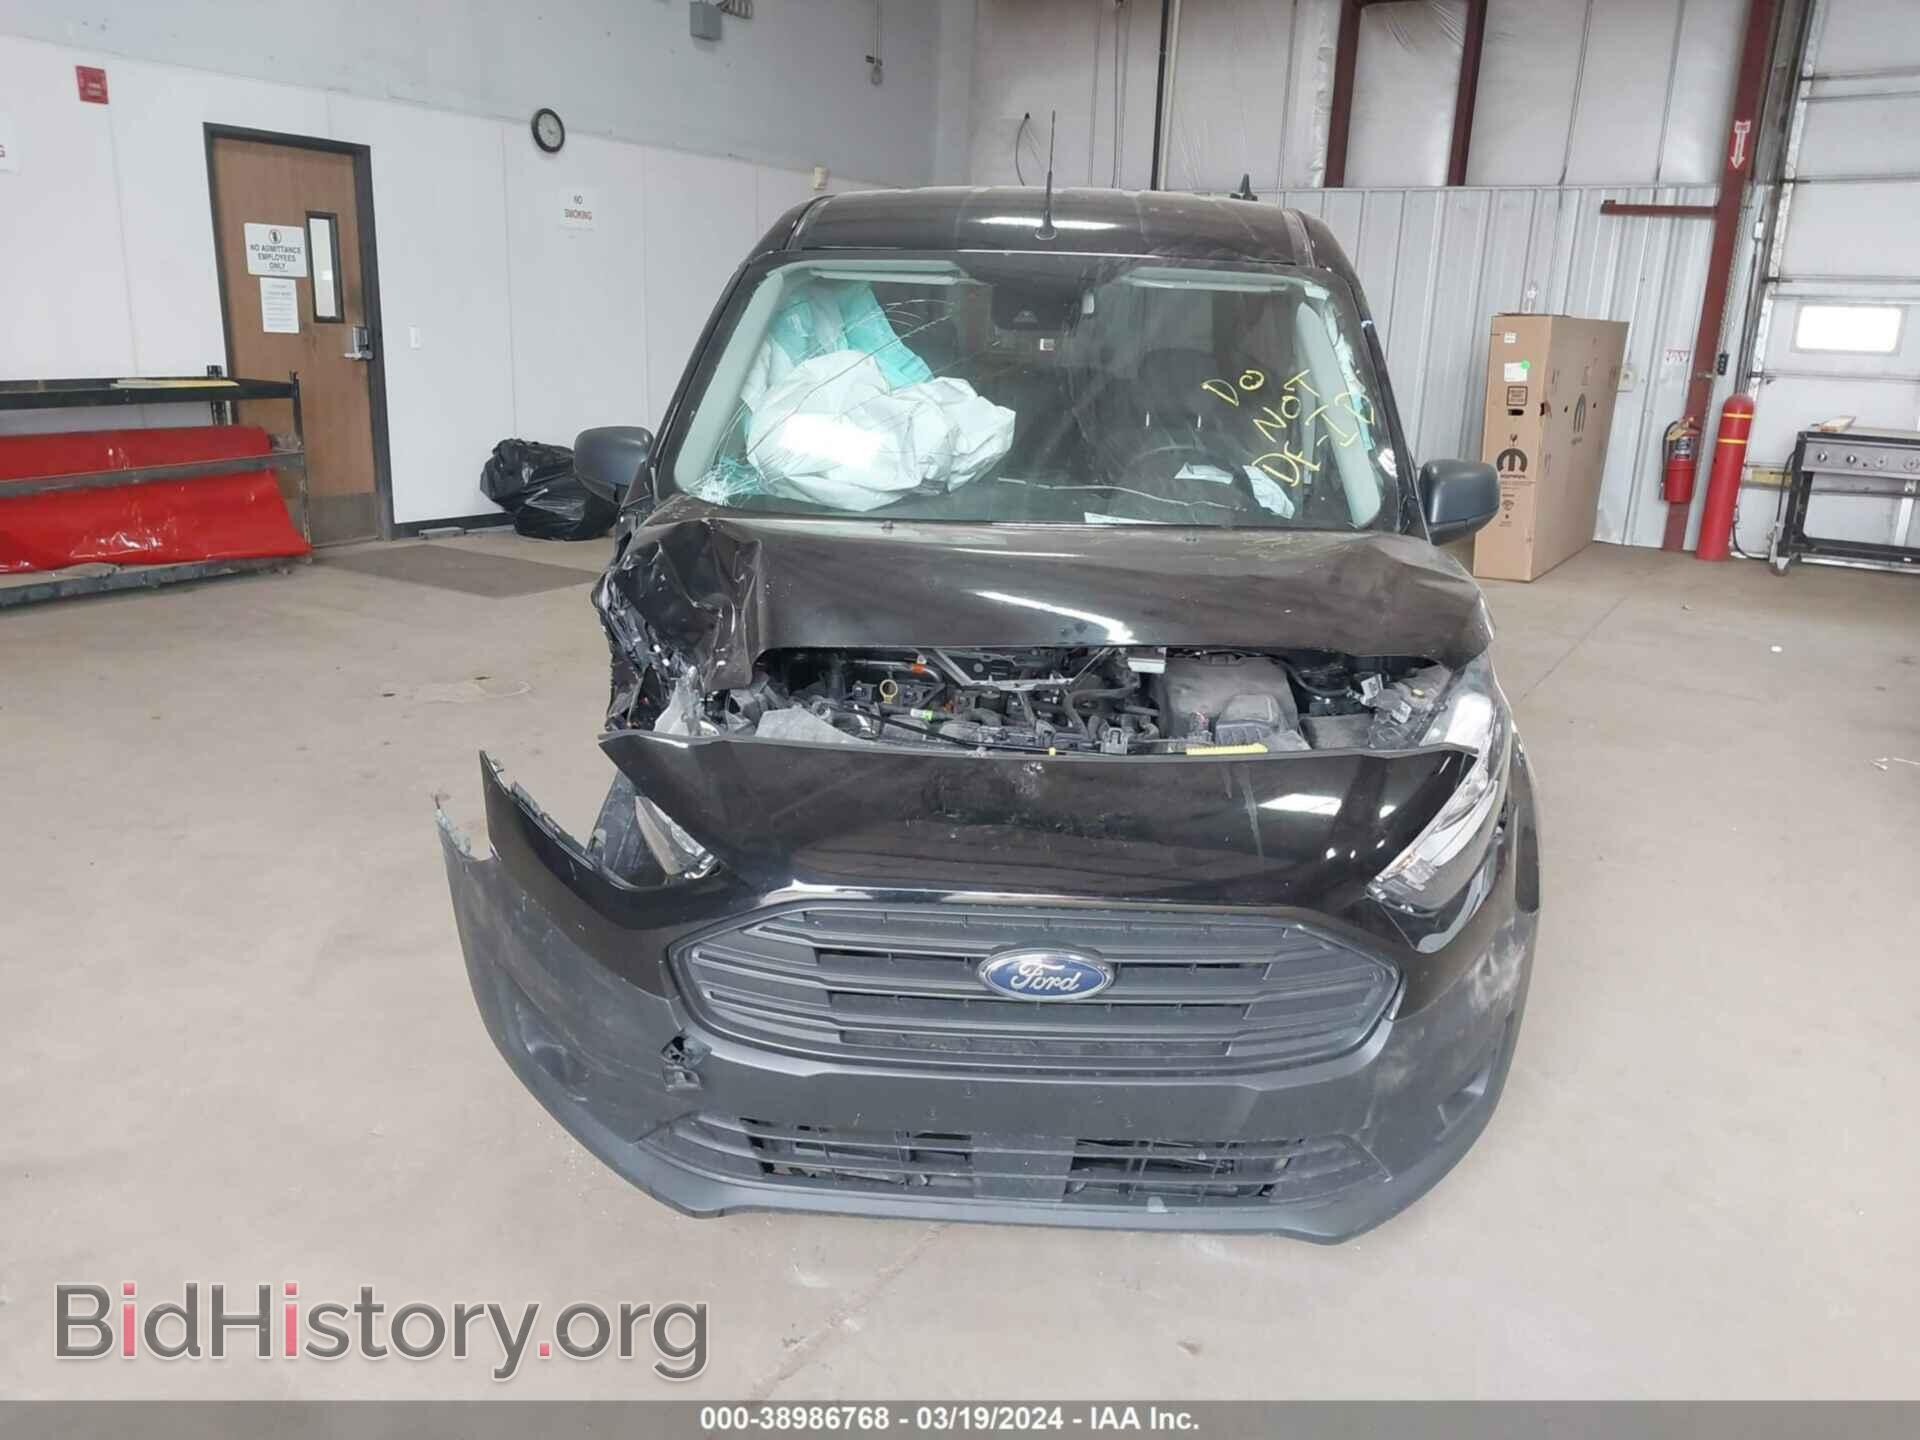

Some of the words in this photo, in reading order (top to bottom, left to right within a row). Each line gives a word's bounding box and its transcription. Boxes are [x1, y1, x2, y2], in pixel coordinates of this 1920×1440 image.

[250, 243, 260, 252] NO
[261, 244, 301, 255] ADMITTANCE
[1201, 370, 1264, 407] DO
[1252, 369, 1320, 443] NOT
[1010, 962, 1082, 990] Ford
